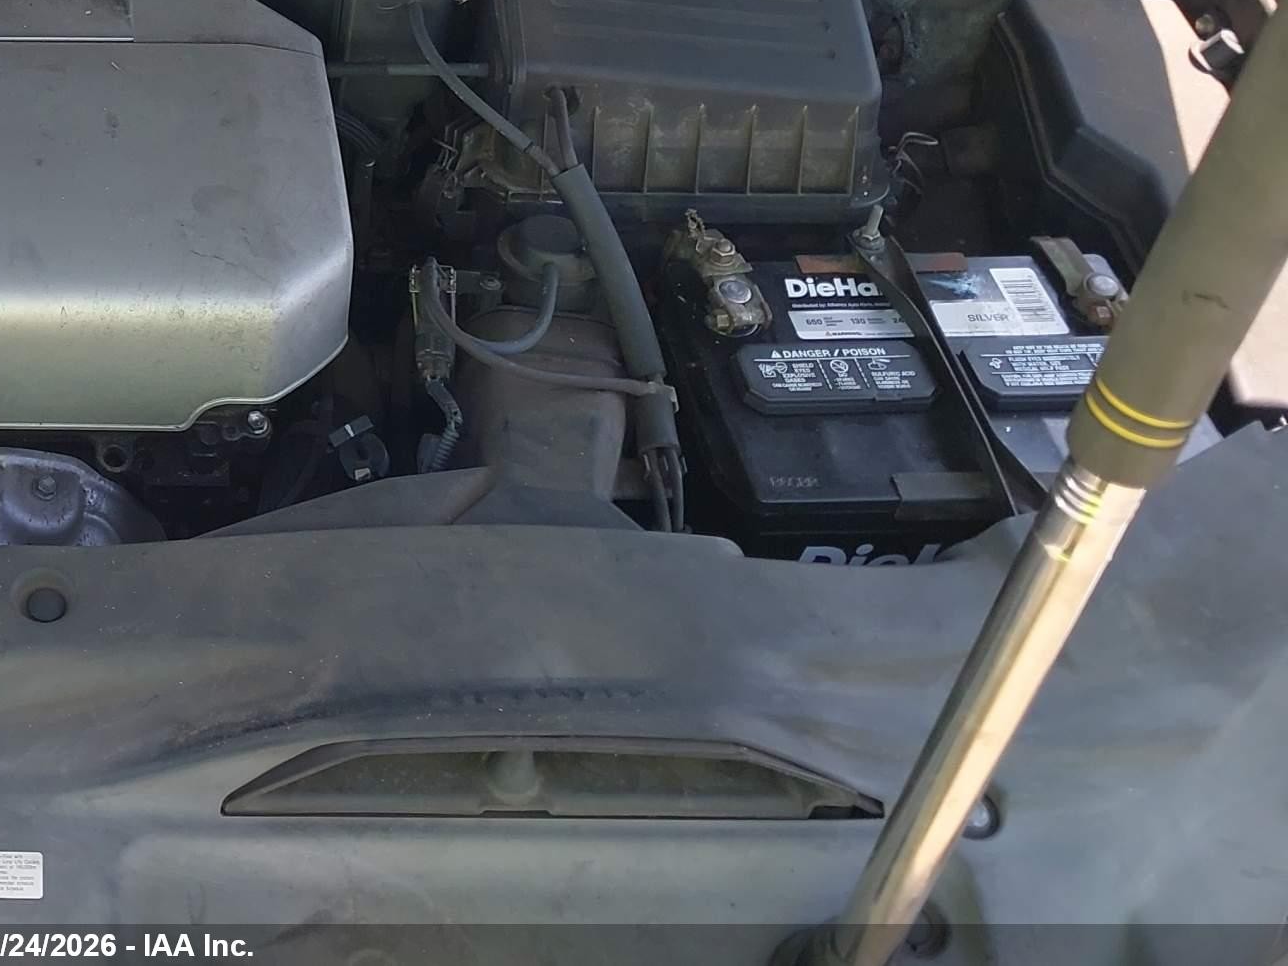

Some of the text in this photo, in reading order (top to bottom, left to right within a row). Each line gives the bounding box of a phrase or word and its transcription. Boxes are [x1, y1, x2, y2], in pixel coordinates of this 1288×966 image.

[784, 277, 883, 298] DieHa
[968, 313, 1009, 322] SILVER
[782, 349, 831, 359] DANGER
[842, 348, 887, 357] POISON
